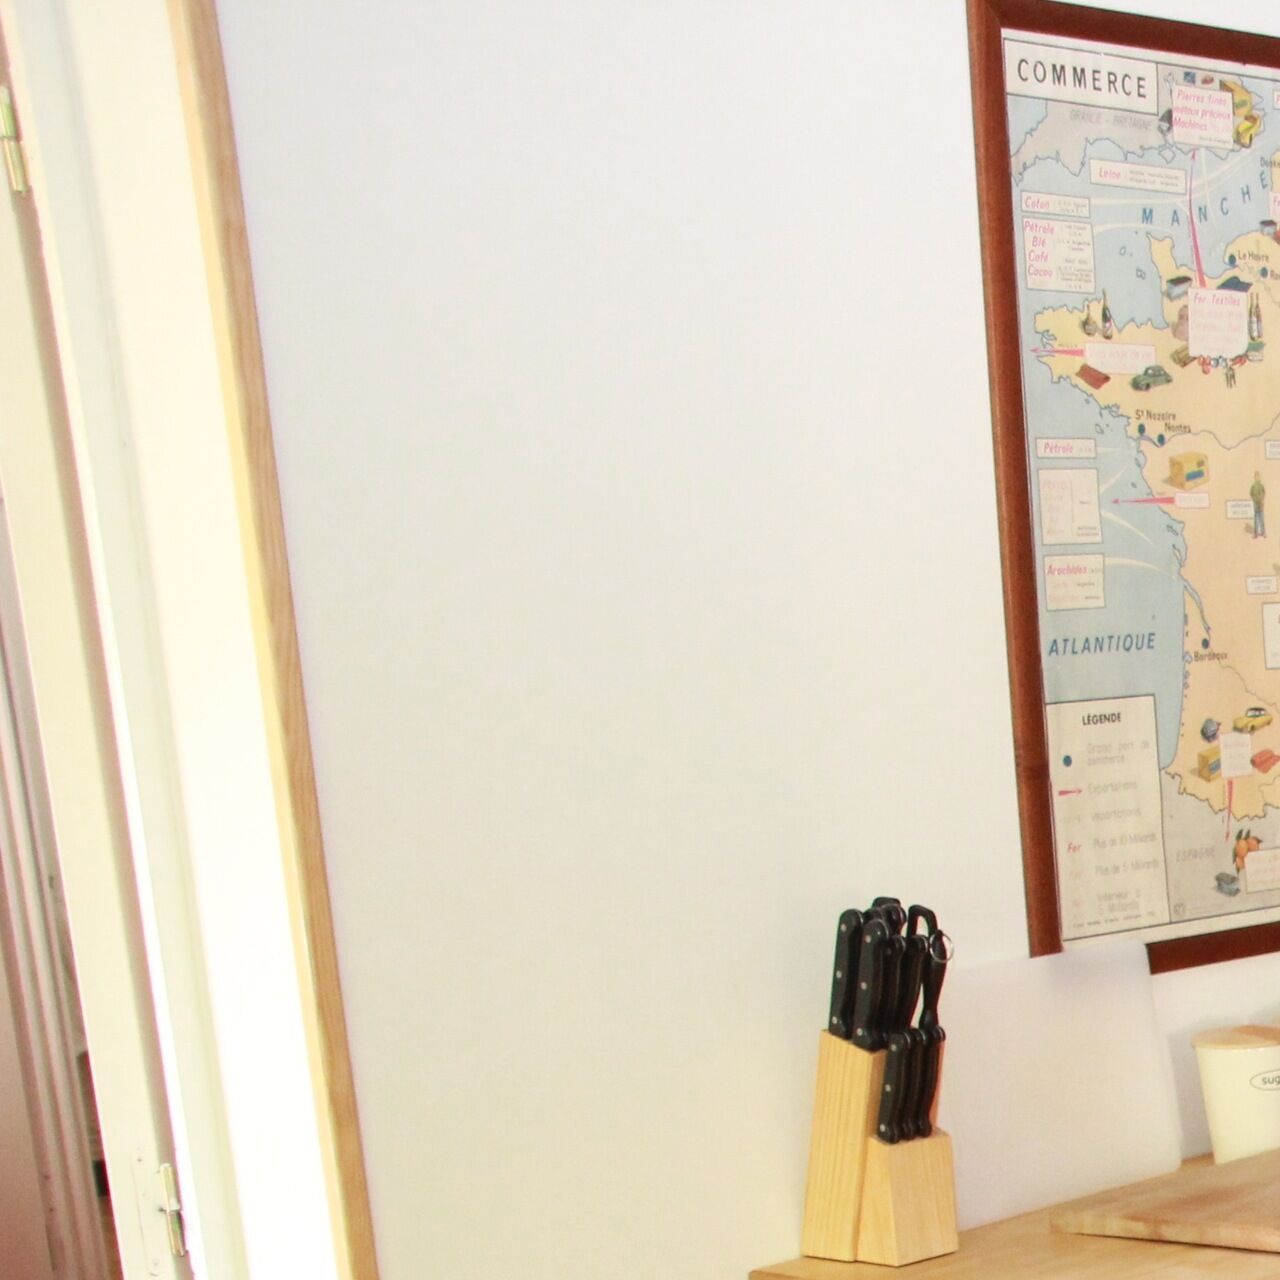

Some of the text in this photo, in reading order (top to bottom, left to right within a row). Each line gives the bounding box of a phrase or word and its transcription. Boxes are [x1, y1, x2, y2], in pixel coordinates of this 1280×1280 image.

[1017, 58, 1146, 98] COMMERCE
[1141, 170, 1269, 226] MANCHE
[1024, 220, 1056, 237] Pétrole
[1032, 235, 1046, 248] Blé
[1028, 249, 1048, 263] Café
[1048, 632, 1156, 657] ATLANTIQUE
[1082, 711, 1122, 727] LÉGENDE
